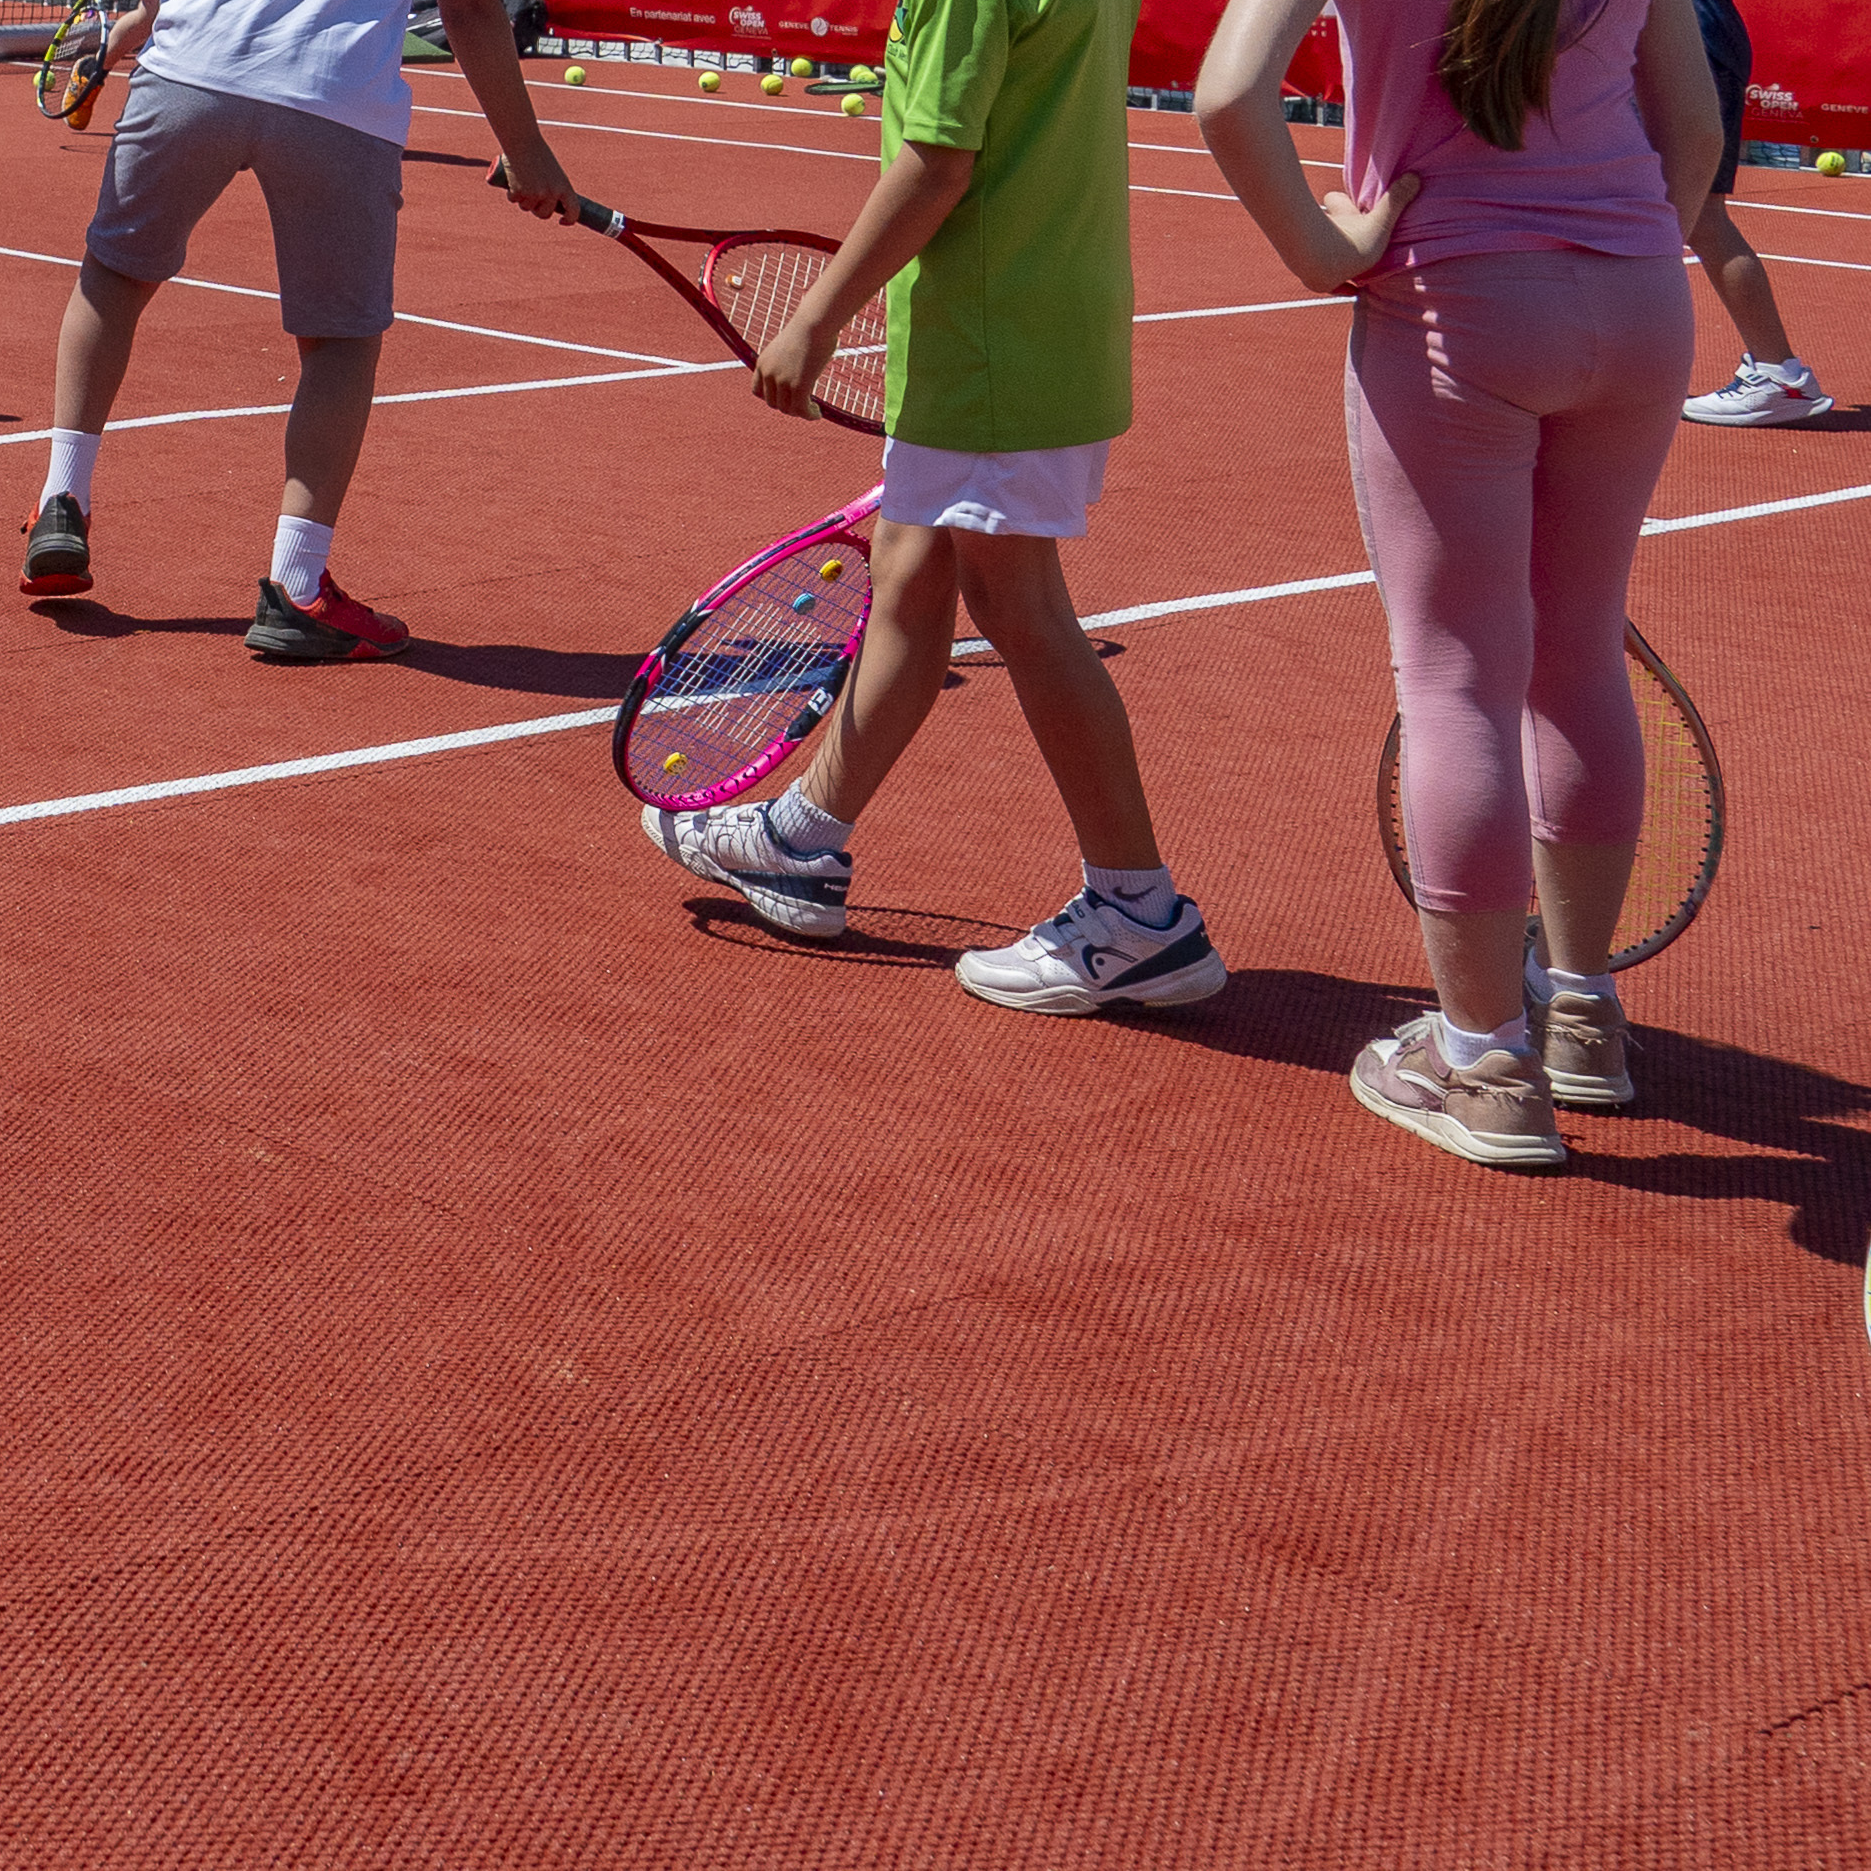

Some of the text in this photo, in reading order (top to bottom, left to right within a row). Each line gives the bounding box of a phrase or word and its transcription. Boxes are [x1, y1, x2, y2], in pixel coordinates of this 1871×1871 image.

[629, 6, 717, 25] En partenariat avec
[733, 10, 762, 21] SWISS
[739, 18, 766, 29] OPEN
[1749, 88, 1794, 103] SWISS
[1759, 98, 1800, 112] OPEN
[1751, 107, 1804, 120] GENEVA
